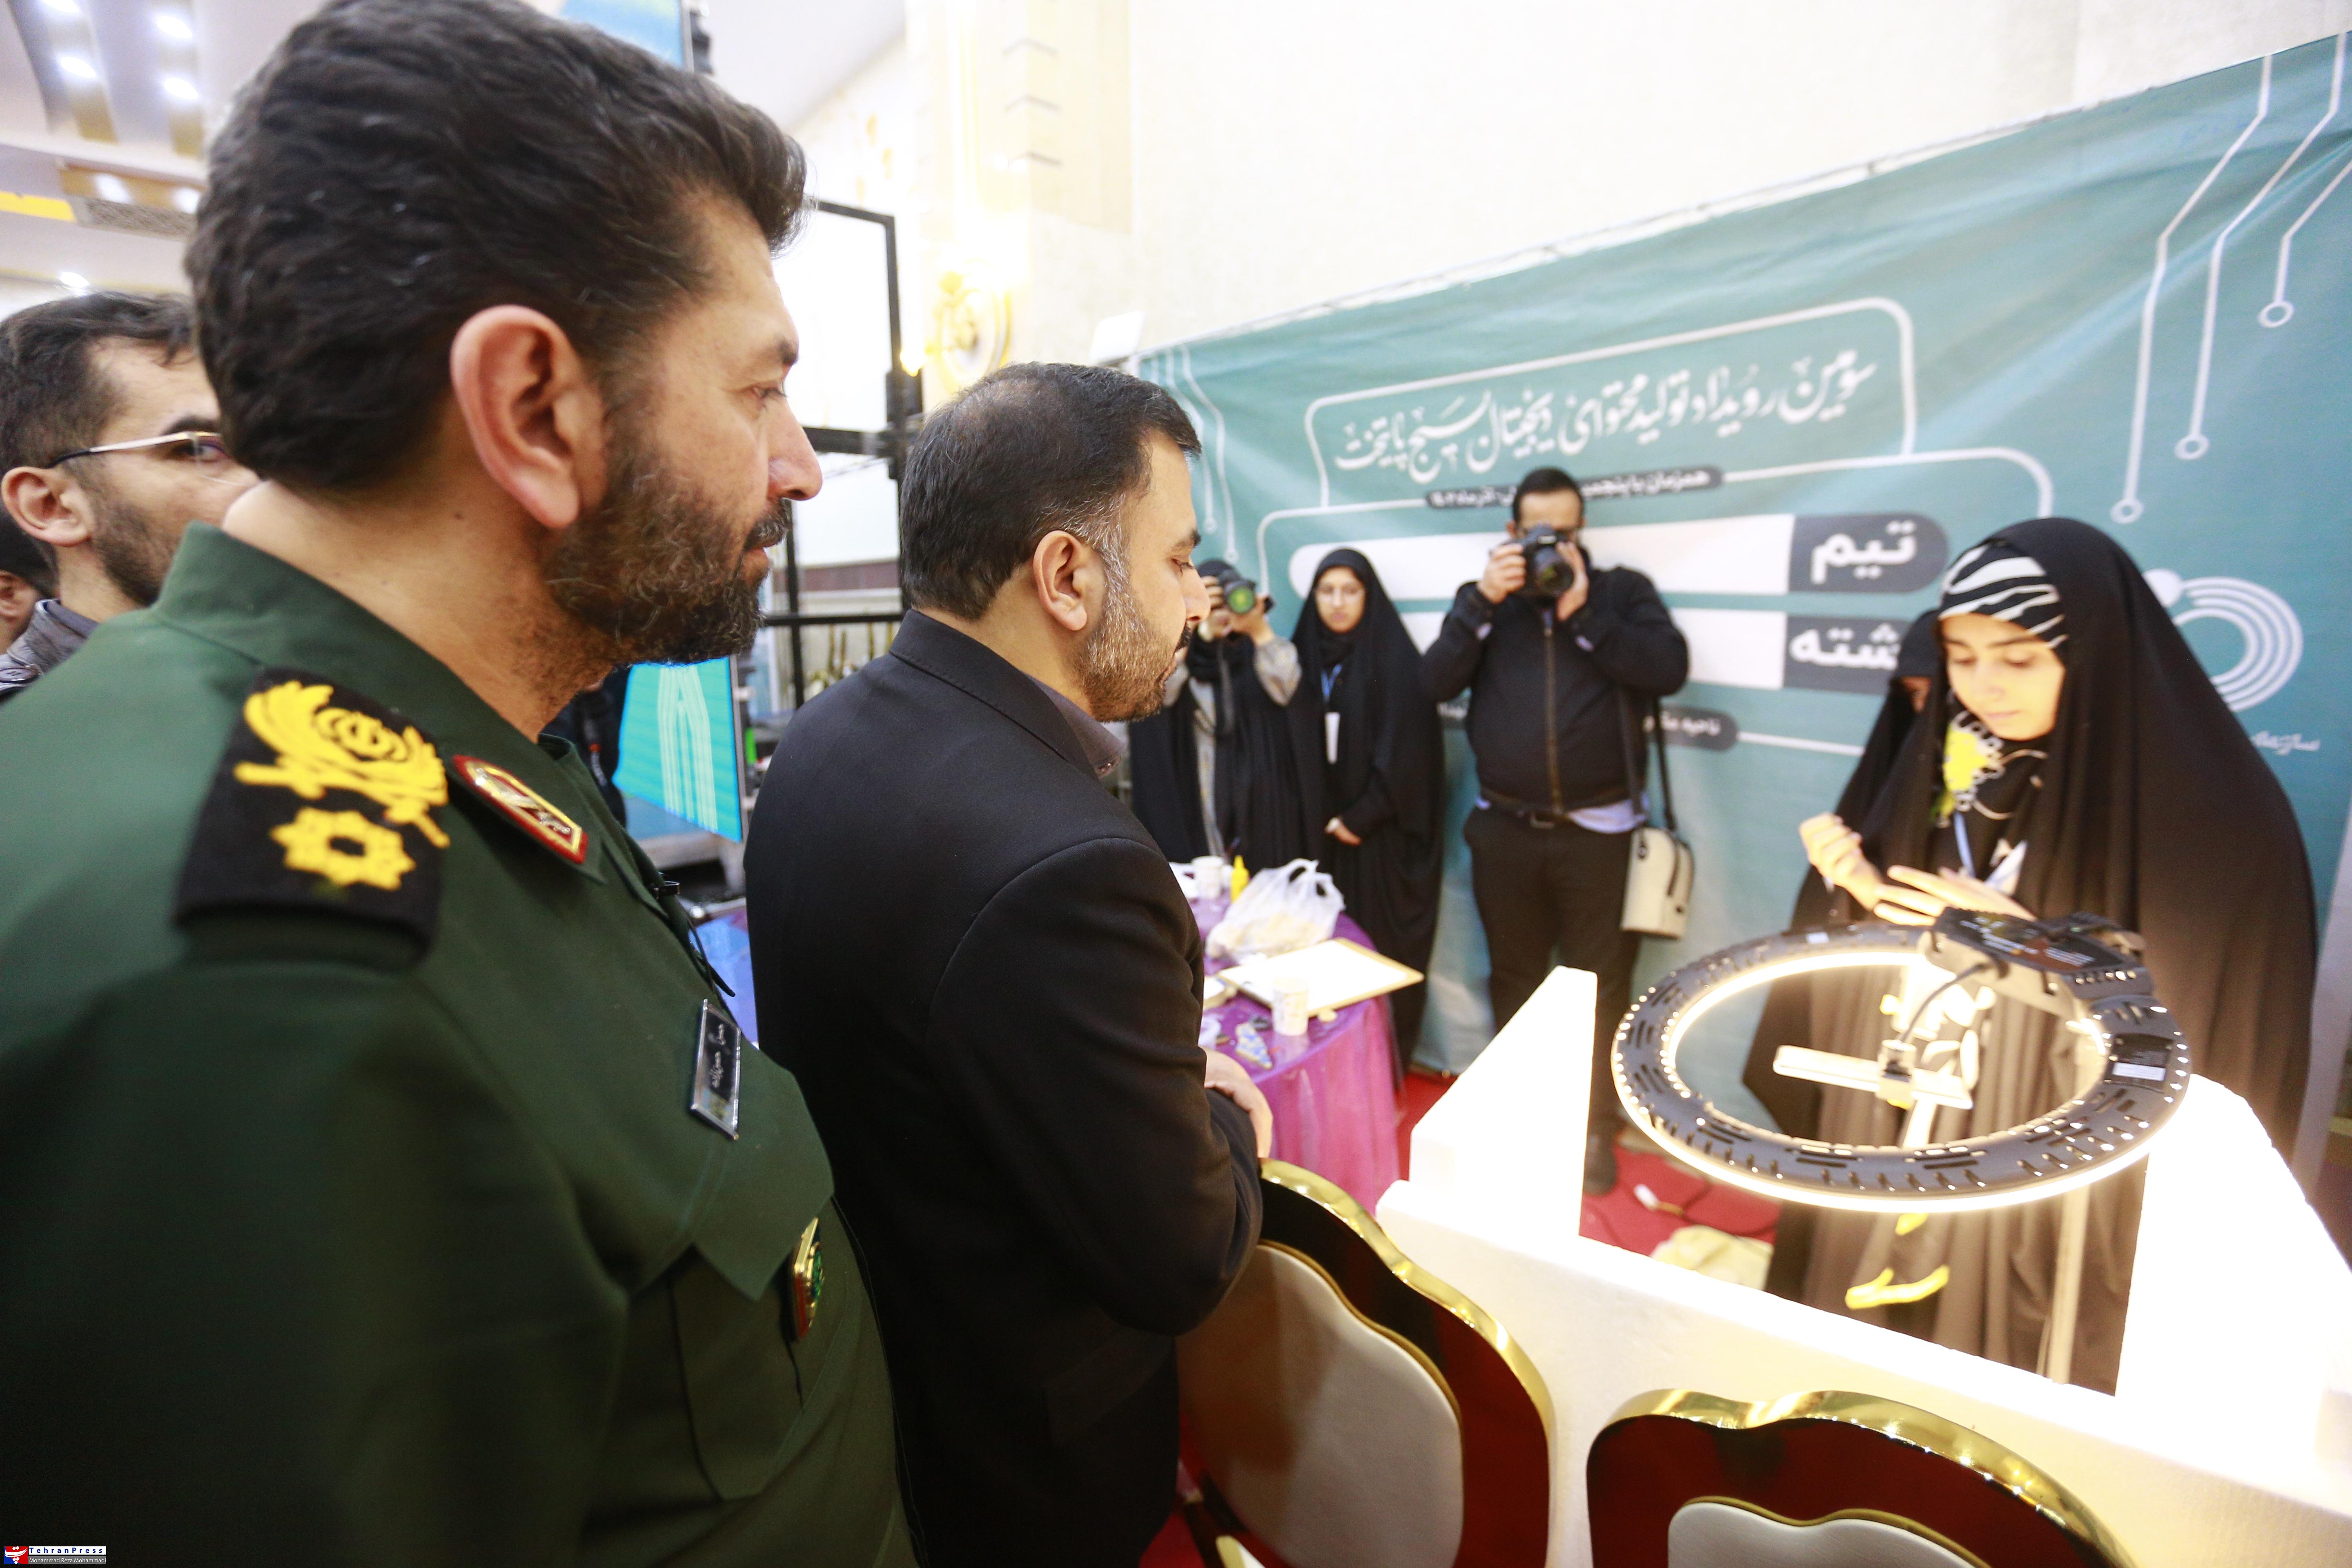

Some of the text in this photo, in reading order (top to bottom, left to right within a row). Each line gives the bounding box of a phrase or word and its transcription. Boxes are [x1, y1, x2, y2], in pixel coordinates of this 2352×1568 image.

[1557, 373, 1650, 456] محتوای
[1624, 369, 1690, 446] تولید
[1691, 364, 1779, 439] رویداد
[1777, 349, 1878, 425] سومین
[1810, 519, 1918, 585] تیم
[1788, 623, 1901, 671] شته
